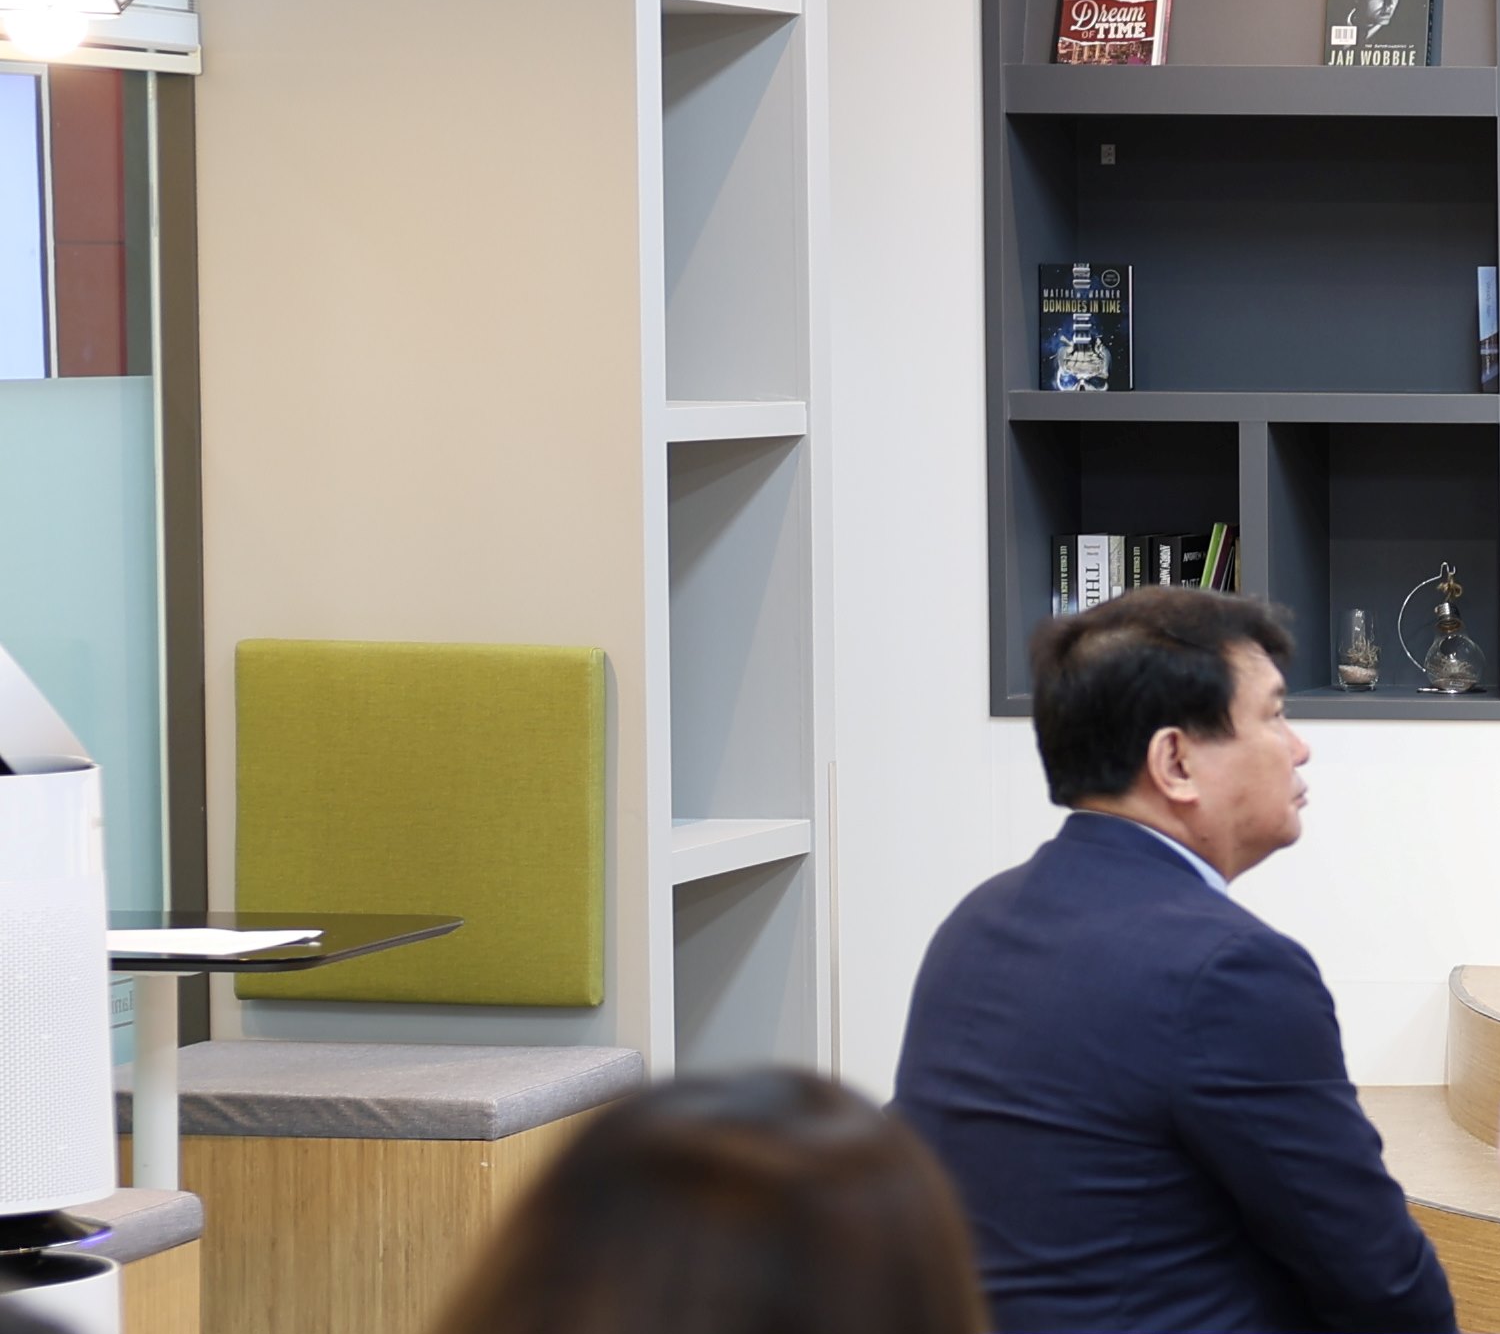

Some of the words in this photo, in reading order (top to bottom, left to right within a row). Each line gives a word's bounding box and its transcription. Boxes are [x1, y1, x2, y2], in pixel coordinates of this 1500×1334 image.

[1095, 22, 1147, 39] TIME
[1328, 49, 1355, 66] JAH
[1360, 50, 1417, 66] WOBBLE
[1042, 299, 1088, 313] DOMINOES
[1089, 299, 1099, 313] IN
[1101, 300, 1121, 314] TIME
[1085, 562, 1100, 608] THE
